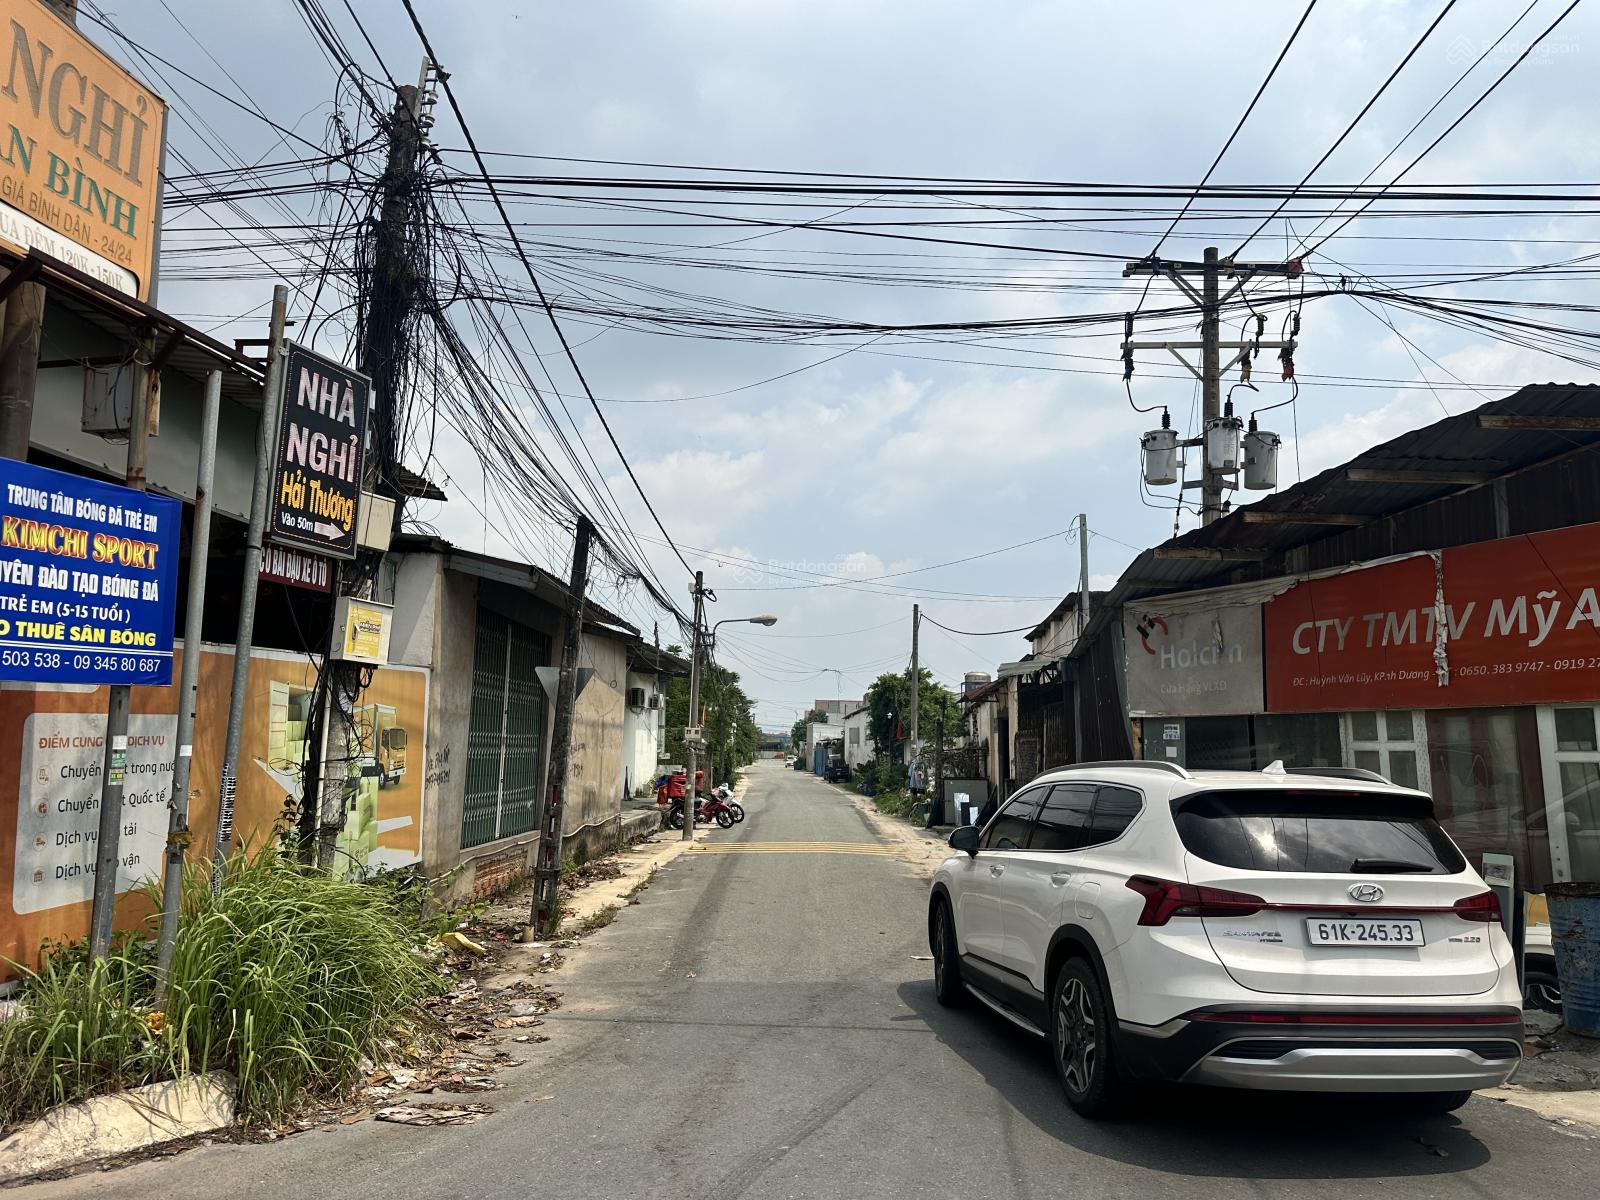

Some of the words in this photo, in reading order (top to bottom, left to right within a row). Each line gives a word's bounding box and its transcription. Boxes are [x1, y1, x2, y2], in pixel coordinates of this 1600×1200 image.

[1, 17, 149, 188] NGHỈ
[44, 149, 140, 241] BÌNH
[2, 175, 25, 203] GIÁ
[29, 191, 61, 227] BÌNH
[64, 214, 91, 244] DÂN
[100, 235, 133, 266] 24/24
[297, 366, 356, 428] NHÀ
[286, 422, 358, 483] NGHỈ
[7, 483, 48, 511] TRUNG
[50, 491, 74, 516] TÂM
[75, 498, 106, 523] BÓNG
[108, 505, 123, 527] ĐÁ
[125, 507, 142, 531] TRẺ
[143, 514, 158, 533] EM
[280, 469, 307, 511] Hải
[309, 479, 354, 532] Thương
[281, 511, 295, 528] Vào
[297, 516, 314, 532] 50m
[1, 515, 89, 560] KIMCHI
[92, 532, 159, 570] SPORT
[38, 563, 68, 591] ĐÀO
[72, 570, 99, 598] TẠO
[102, 574, 139, 600] BÓNG
[142, 579, 159, 602] ĐÁ
[301, 556, 311, 584] XE
[312, 554, 318, 585] Ô
[318, 556, 327, 587] TÔ
[0, 594, 28, 613] TRẺ
[31, 600, 53, 615] EM
[56, 601, 89, 619] (5-15
[91, 602, 124, 622] TUỔI
[1292, 616, 1355, 655] CTY
[1483, 589, 1561, 648] Mỹ
[15, 621, 66, 641] THUÊ
[70, 624, 106, 644] SÂN
[110, 628, 157, 647] BÓNG
[2, 651, 30, 667] 503
[34, 653, 61, 669] 538
[73, 655, 91, 670] 09
[94, 656, 118, 671] 345
[120, 657, 136, 672] 80
[139, 659, 161, 673] 687
[1515, 661, 1544, 673] 9747
[1554, 658, 1585, 670] 0919
[38, 731, 70, 749] ĐIỂM
[72, 736, 103, 749] CUNG
[128, 735, 149, 749] DỊCH
[61, 760, 102, 781] Chuyển
[131, 763, 157, 776] trong
[58, 794, 99, 814] Chuyển
[129, 789, 153, 808] Quốc
[155, 787, 167, 802] tế
[56, 830, 81, 848] Dịch
[84, 830, 98, 844] vụ
[124, 822, 137, 836] tải
[55, 862, 81, 881] Dịch
[122, 853, 140, 869] vận
[1318, 923, 1414, 941] 61K-245.33
